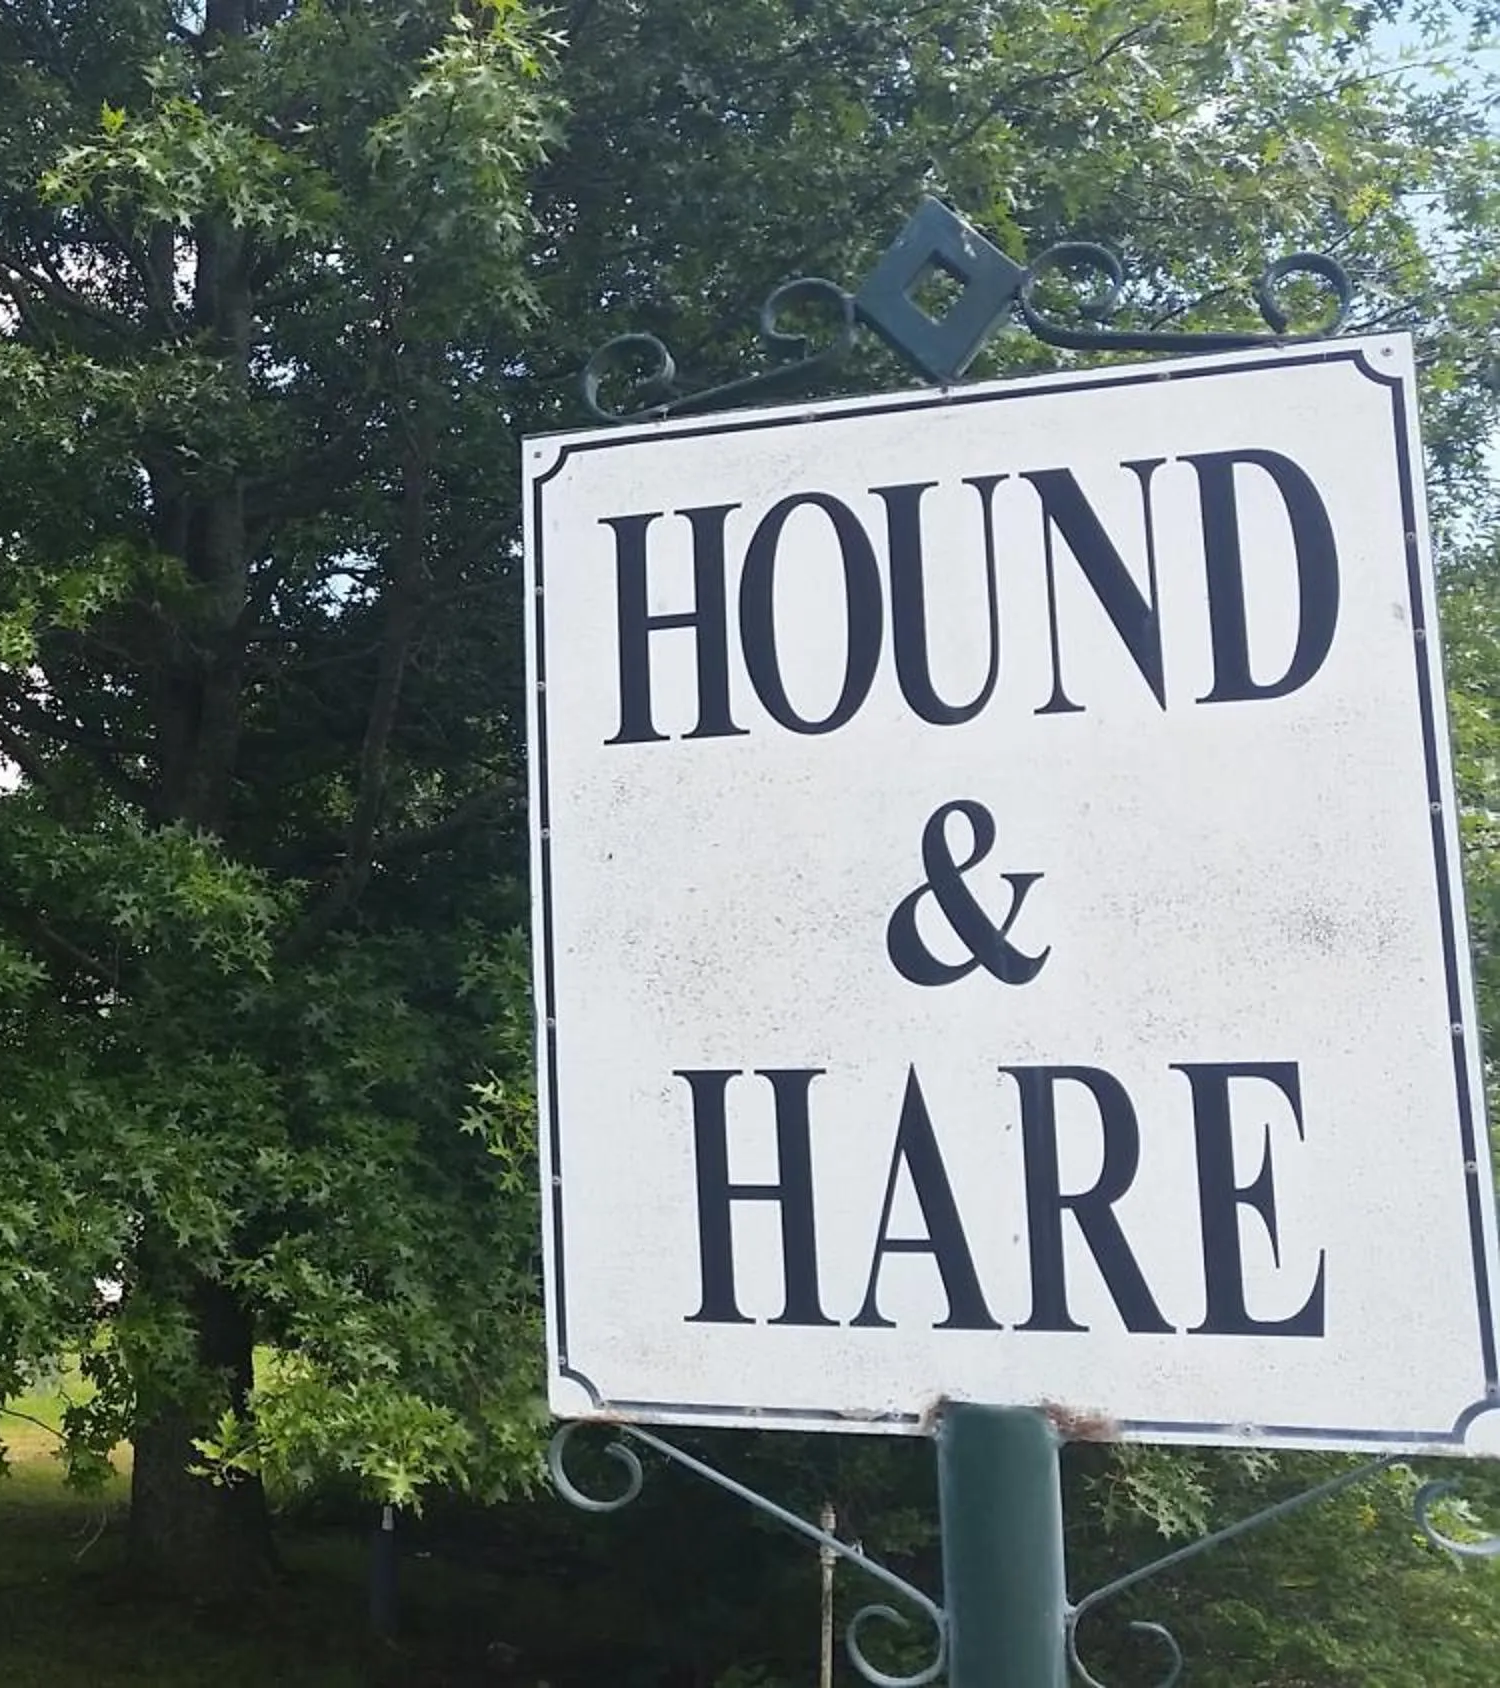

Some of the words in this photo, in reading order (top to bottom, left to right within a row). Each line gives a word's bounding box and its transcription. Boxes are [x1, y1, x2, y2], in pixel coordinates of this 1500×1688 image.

[598, 447, 1341, 745] HOUND
[886, 799, 1051, 987] &
[672, 1062, 1326, 1338] HARE
